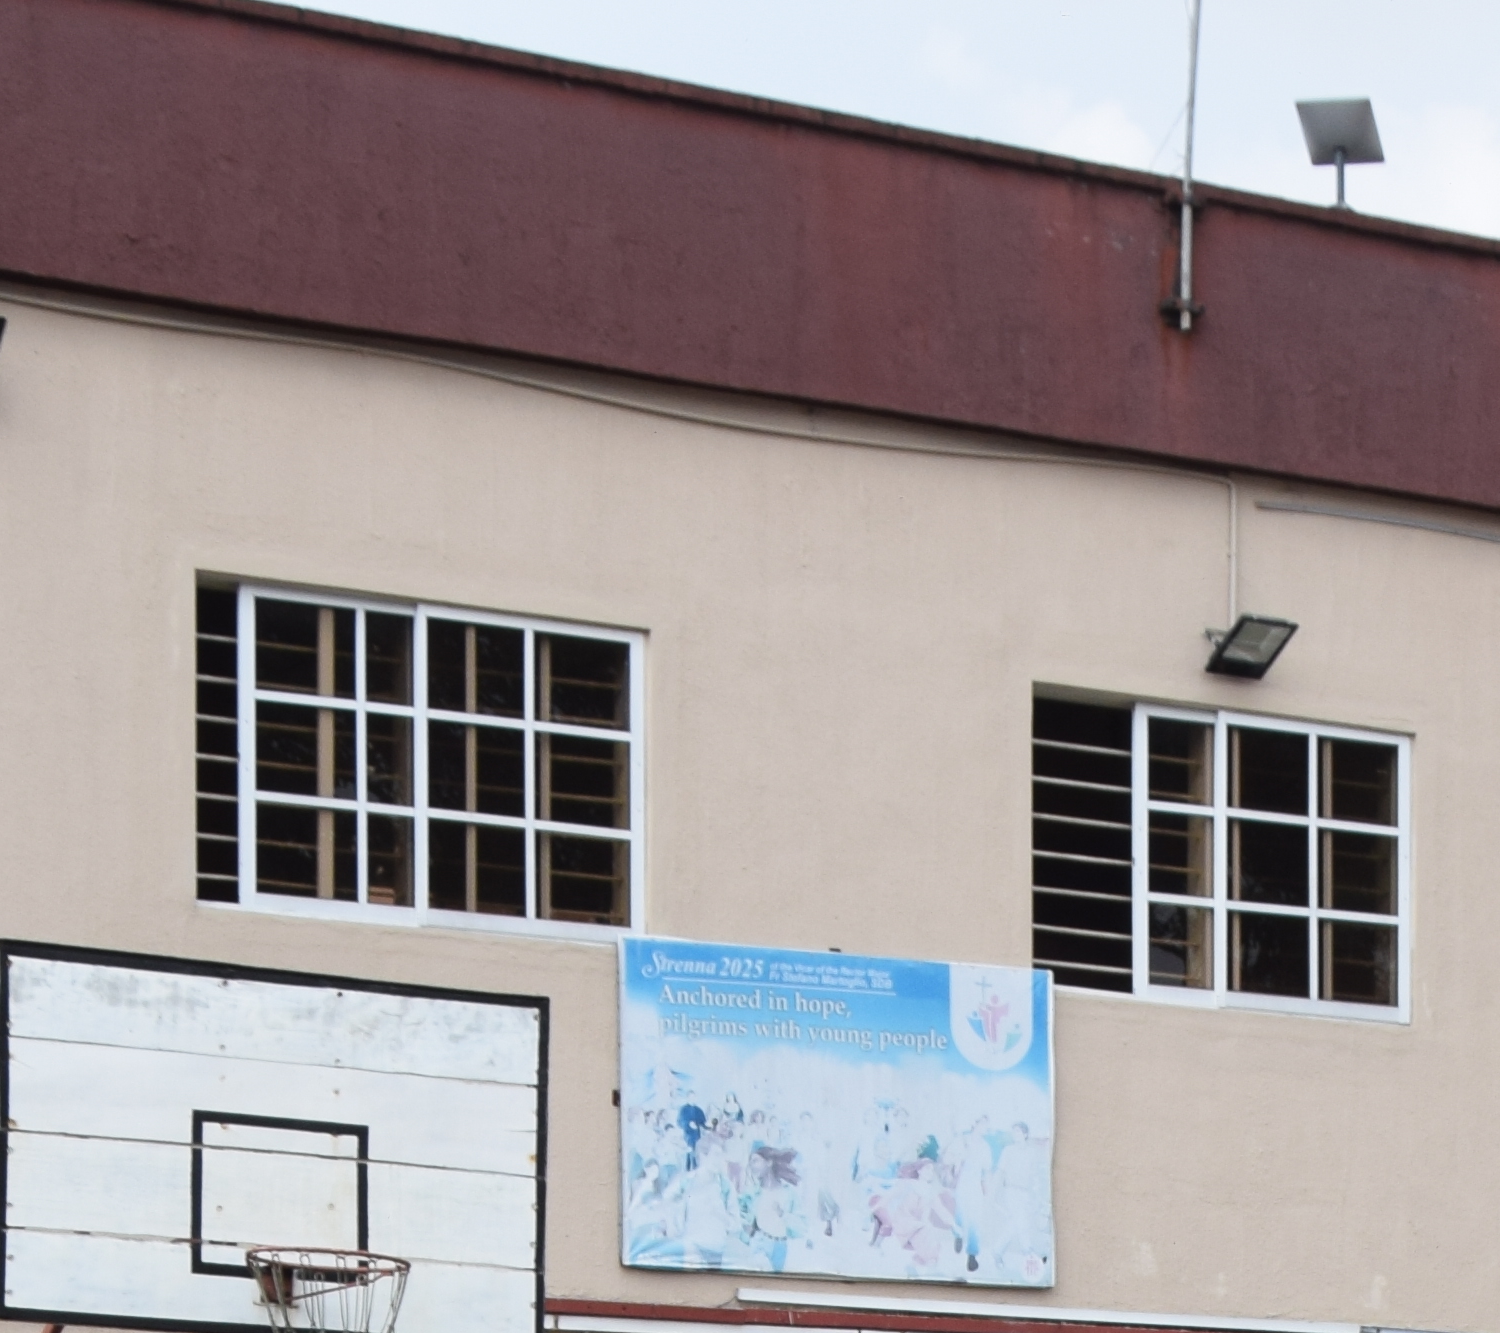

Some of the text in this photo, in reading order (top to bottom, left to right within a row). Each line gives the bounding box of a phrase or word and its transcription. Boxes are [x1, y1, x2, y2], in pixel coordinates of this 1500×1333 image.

[641, 951, 765, 979] Strenna 2025
[659, 984, 852, 1019] Anchored in hope,
[658, 1013, 948, 1053] pilgrims with young people
